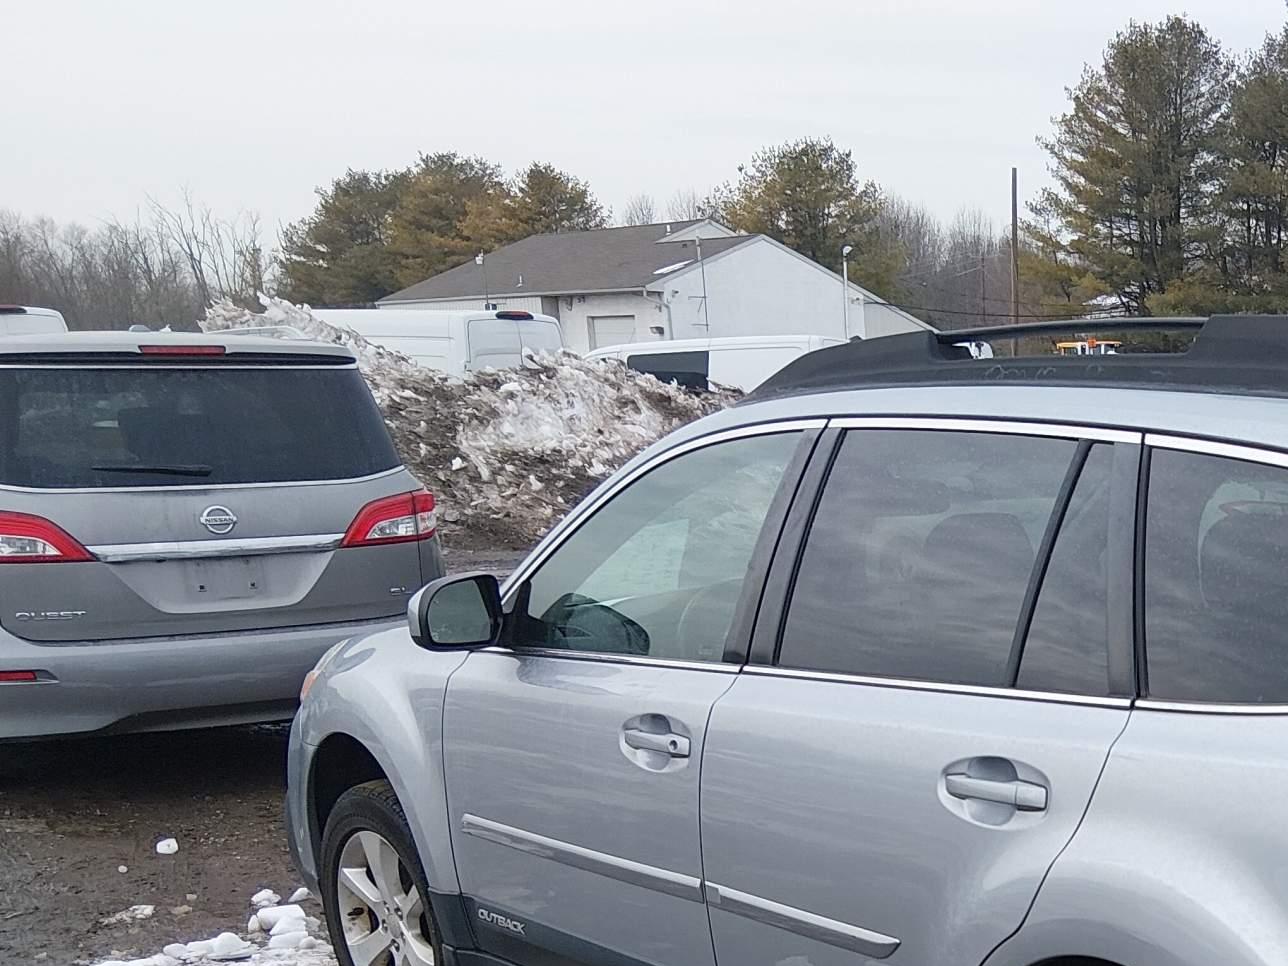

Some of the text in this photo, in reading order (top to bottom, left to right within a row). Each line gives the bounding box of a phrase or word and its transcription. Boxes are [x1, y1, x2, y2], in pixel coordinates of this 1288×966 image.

[204, 516, 233, 525] NISSAN
[15, 610, 87, 621] QUEST
[478, 908, 526, 936] OUTBACK
